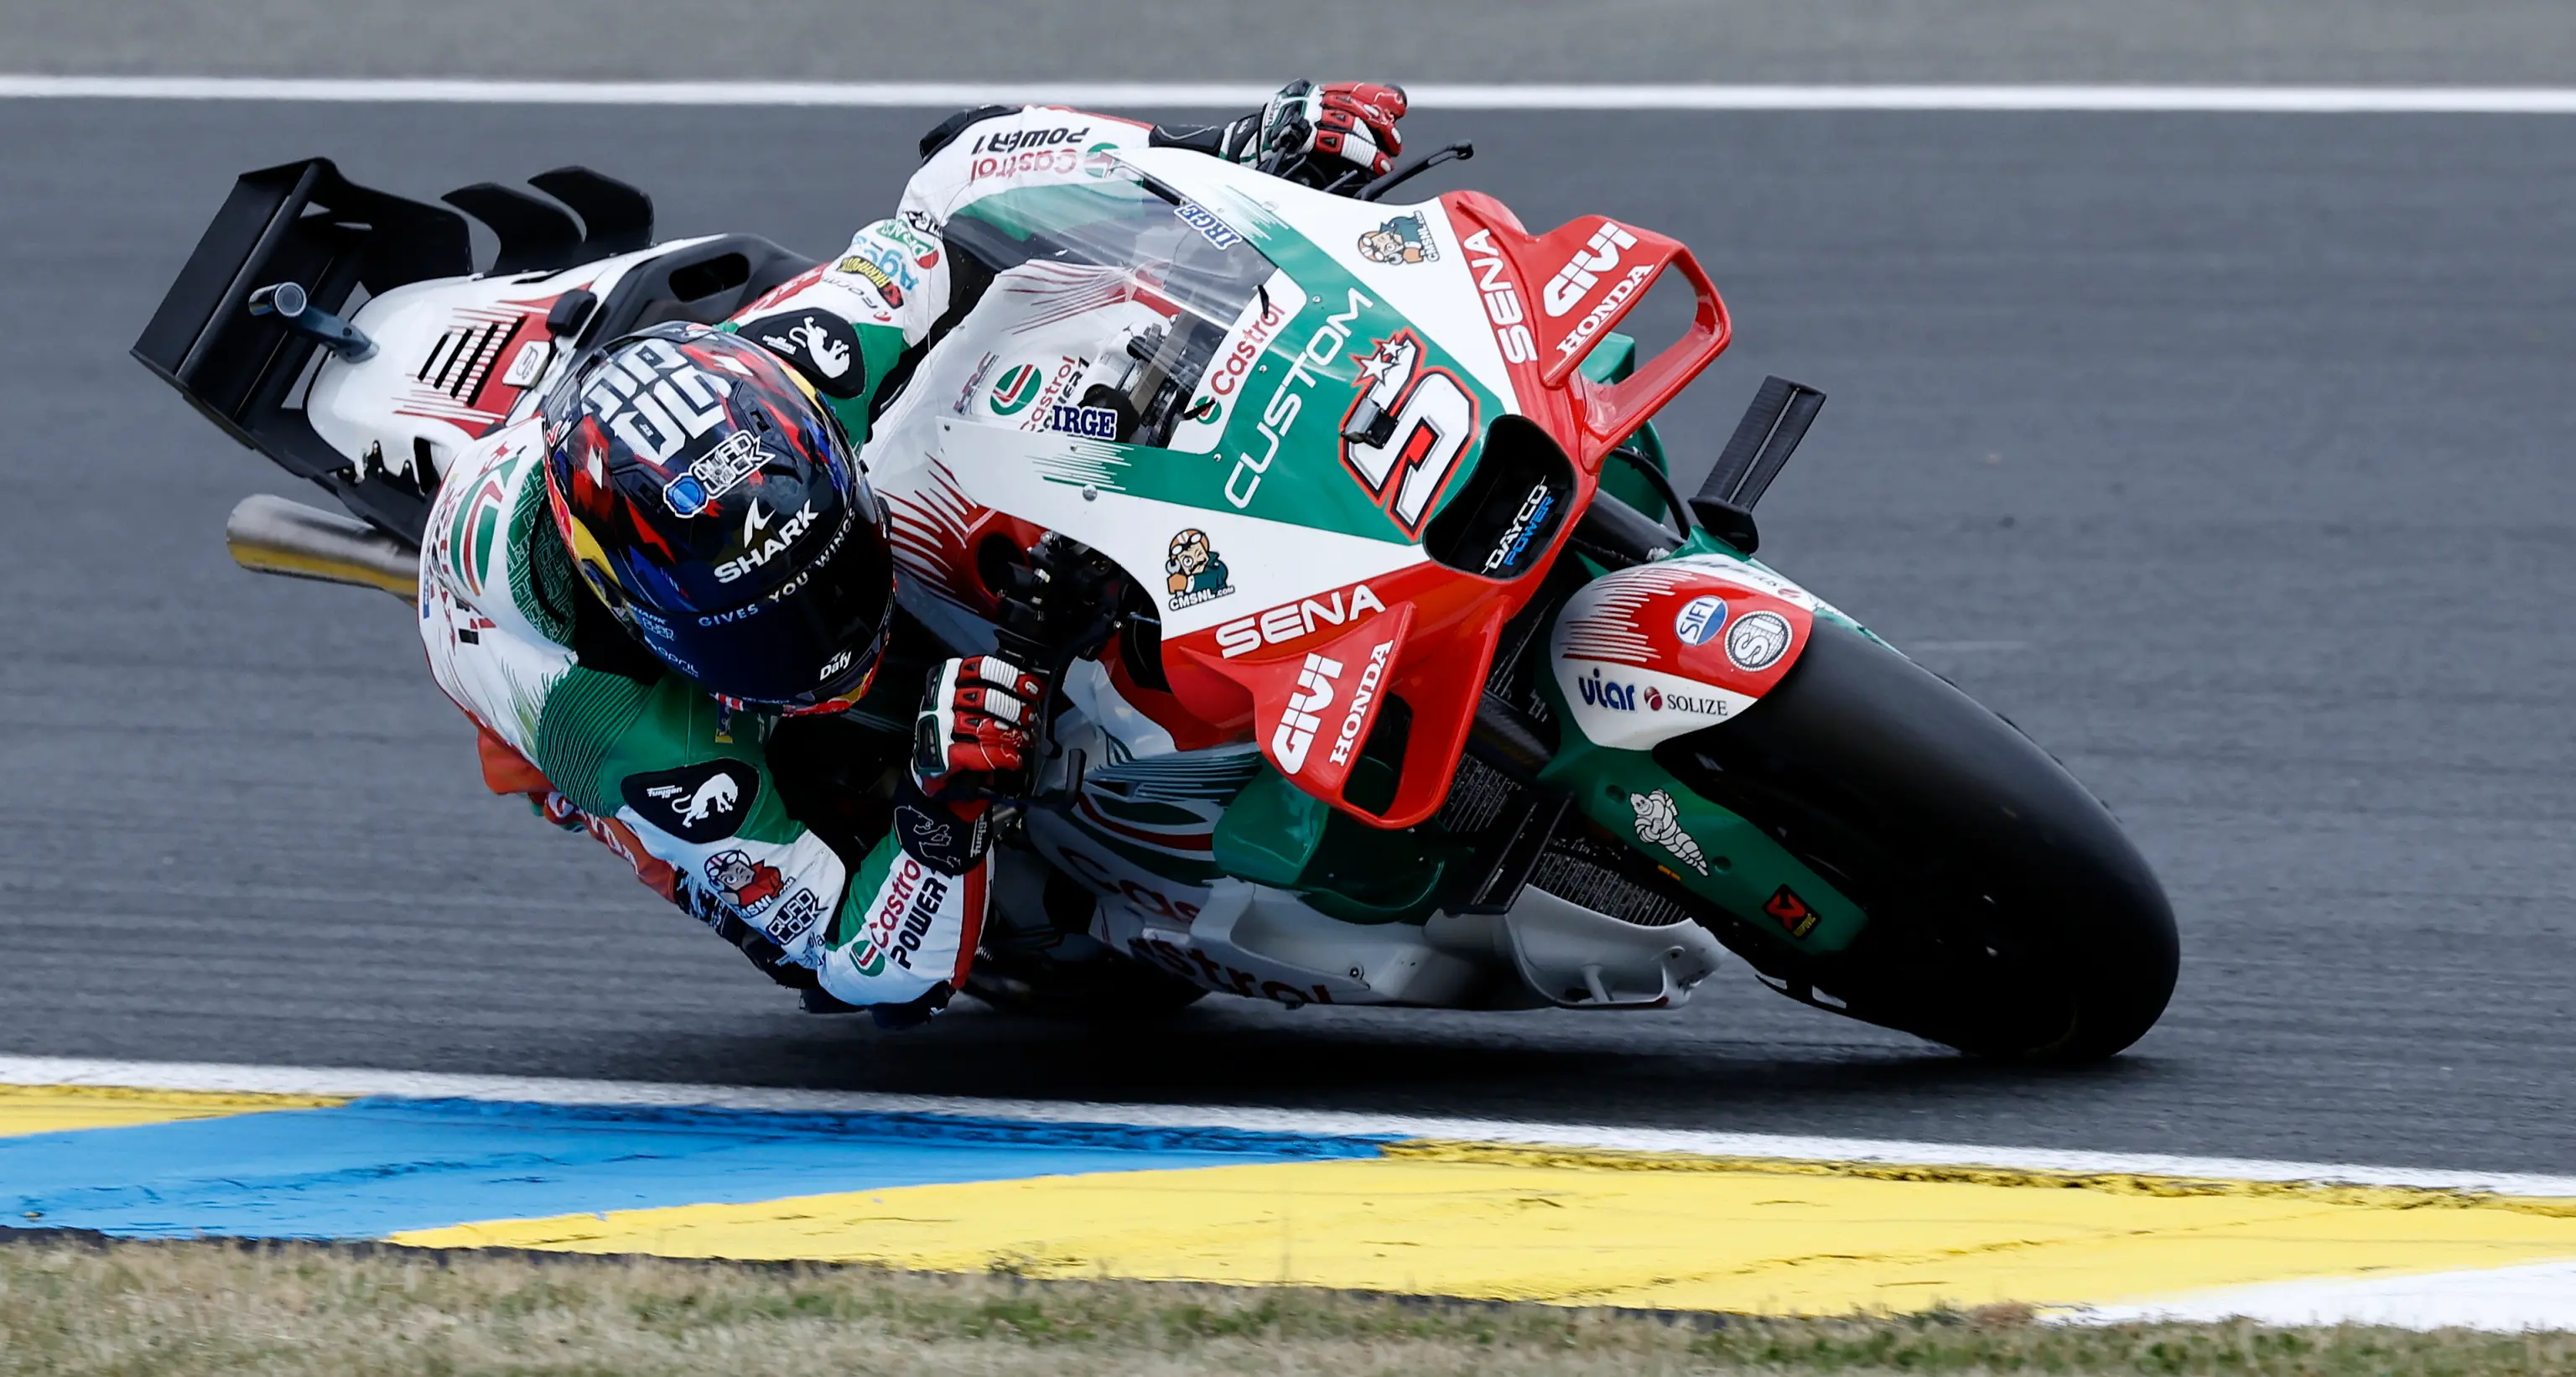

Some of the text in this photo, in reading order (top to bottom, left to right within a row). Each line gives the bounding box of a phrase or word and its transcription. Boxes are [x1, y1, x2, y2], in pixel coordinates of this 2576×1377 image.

[970, 148, 1078, 182] Castrol
[1176, 205, 1240, 247] IRGE
[1464, 229, 1538, 364] SENA
[1543, 221, 1638, 318] GIVI
[1211, 302, 1285, 395] Castrol
[1556, 264, 1654, 356] HONDA
[1052, 406, 1116, 439] IRGE
[1224, 288, 1374, 509] CUSTOM
[1343, 332, 1474, 534] 5
[693, 435, 751, 481] QUAD
[704, 447, 764, 494] LOCK
[714, 498, 818, 584] SHARK
[1485, 484, 1548, 569] DAYCO
[1504, 496, 1555, 565] POWER
[699, 507, 855, 626] GIVES YOU WINGS
[1215, 585, 1386, 659] SENA
[1680, 600, 1714, 640] SIFI
[820, 651, 851, 681] Dafy
[1329, 640, 1393, 766] HONDA
[1667, 694, 1729, 717] SOLIZE
[1271, 652, 1343, 774] GIVI
[768, 890, 814, 936] QUAD
[777, 902, 823, 943] LOCK
[870, 859, 921, 948] Castro
